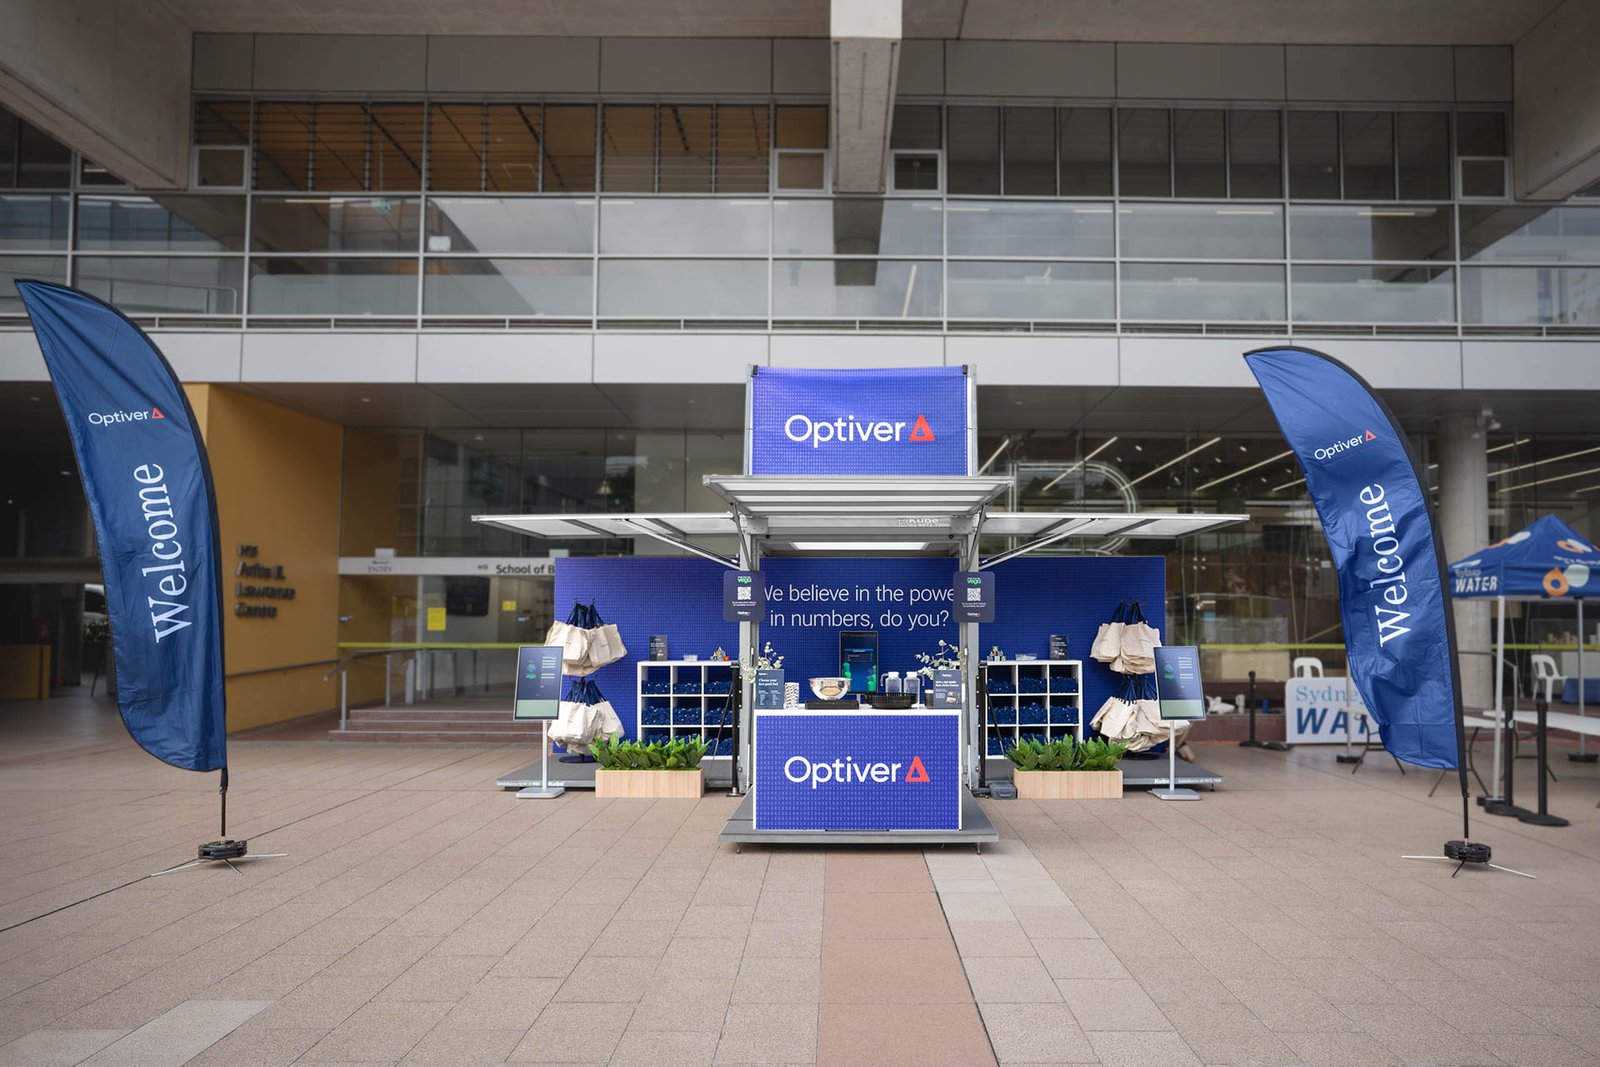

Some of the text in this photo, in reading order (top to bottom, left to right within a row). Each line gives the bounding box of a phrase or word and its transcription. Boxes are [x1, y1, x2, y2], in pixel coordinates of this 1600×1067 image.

[88, 409, 149, 427] Optiver
[784, 414, 906, 449] Optiver
[1314, 434, 1364, 460] Optiver
[133, 462, 192, 645] Welcome
[495, 564, 531, 574] School
[533, 564, 545, 574] of
[1358, 482, 1412, 649] Welcome
[789, 584, 850, 602] believe
[855, 585, 870, 602] in
[875, 584, 904, 602] the
[1455, 575, 1498, 593] WATER
[770, 609, 950, 631] in numbers, do you?
[1296, 685, 1364, 705] Sydne
[785, 755, 902, 789] Optiver
